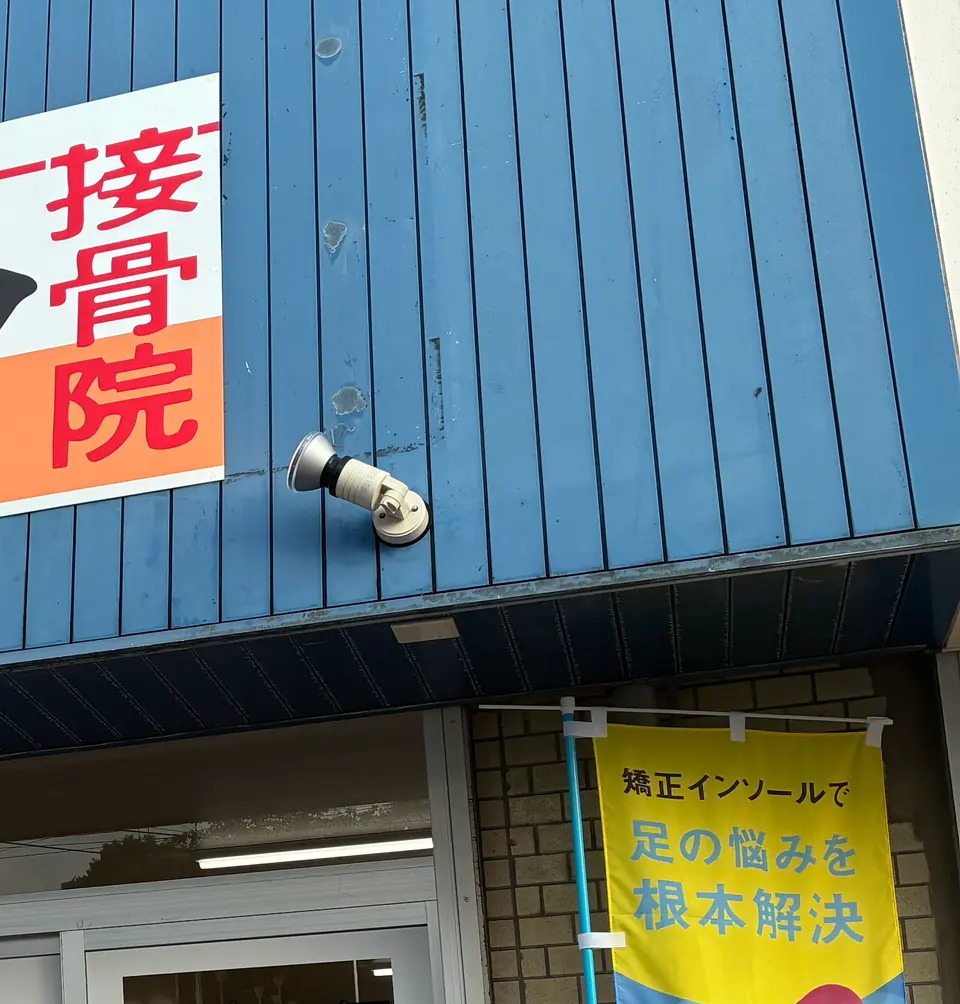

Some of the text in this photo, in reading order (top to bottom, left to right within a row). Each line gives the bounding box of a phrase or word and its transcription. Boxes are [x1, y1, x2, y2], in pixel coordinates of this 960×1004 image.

[46, 127, 203, 469] 接骨院
[622, 767, 850, 808] 矯正インソールで
[630, 820, 856, 877] 足の悩みを
[632, 878, 865, 944] 根本解決
